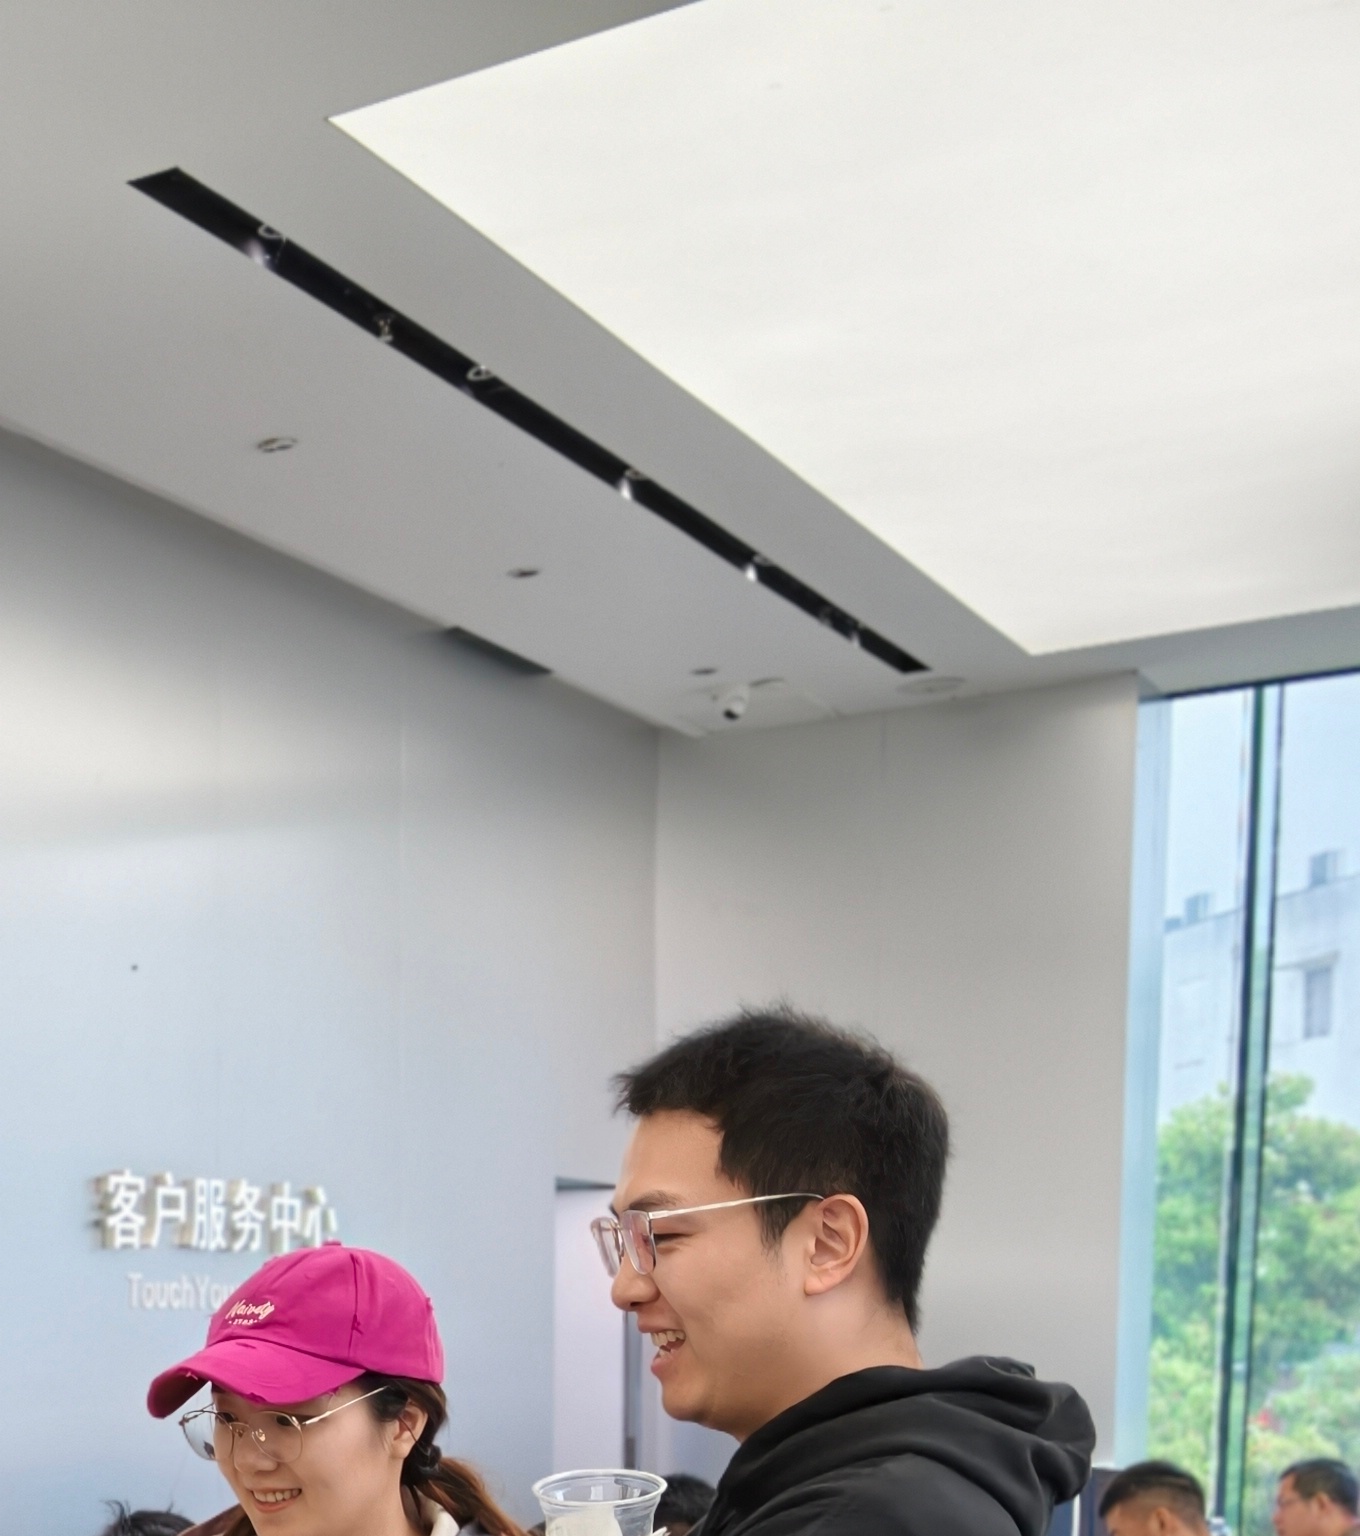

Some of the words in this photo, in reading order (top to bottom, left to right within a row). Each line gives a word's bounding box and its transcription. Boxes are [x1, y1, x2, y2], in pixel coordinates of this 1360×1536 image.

[104, 1169, 338, 1254] 客户服务中心
